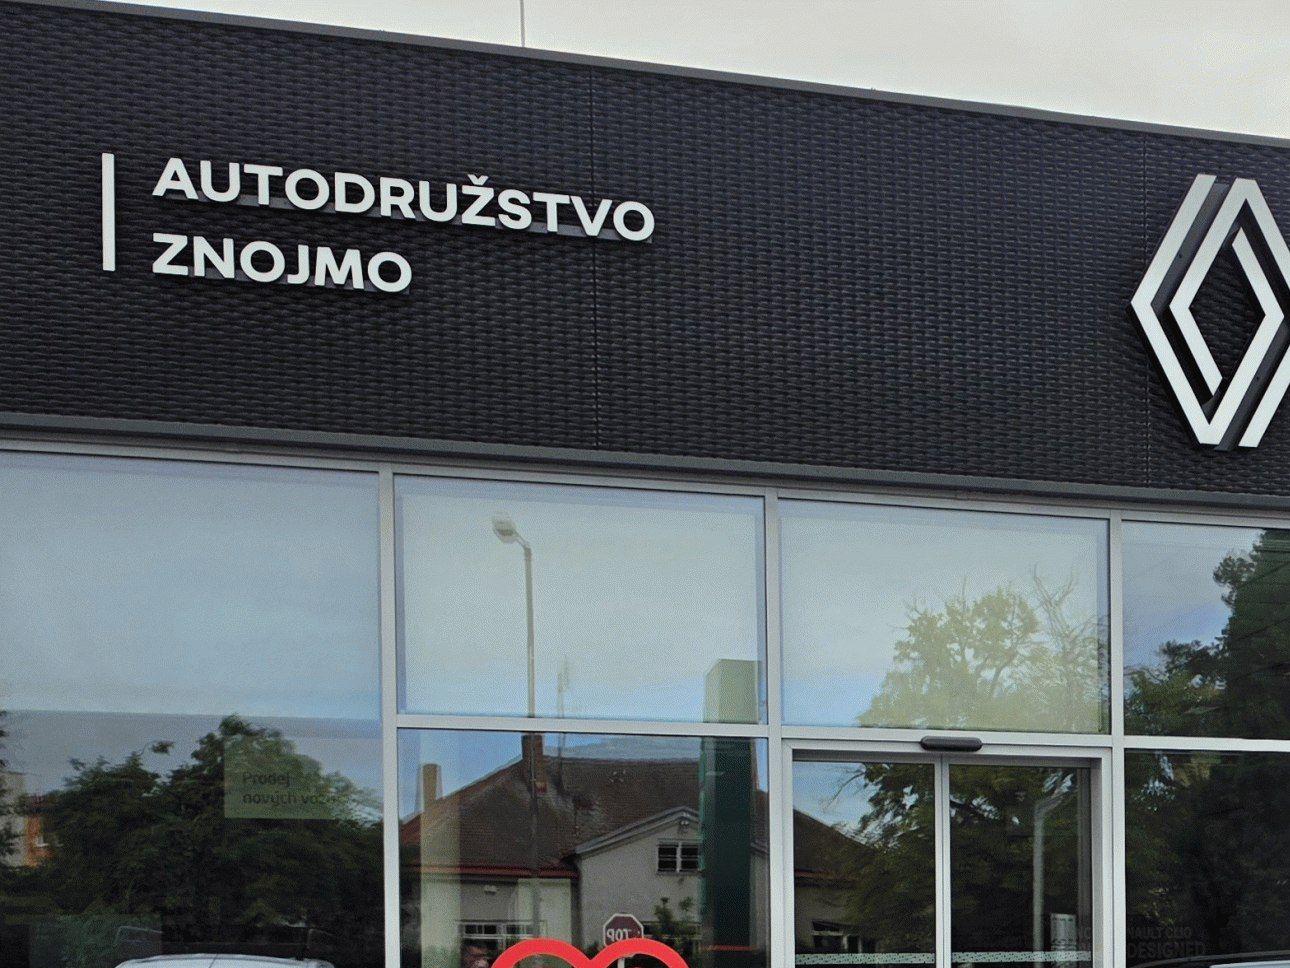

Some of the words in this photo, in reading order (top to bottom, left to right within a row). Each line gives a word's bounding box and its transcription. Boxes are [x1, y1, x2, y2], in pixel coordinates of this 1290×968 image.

[152, 157, 655, 242] AUTODRUŽSTVO
[152, 232, 412, 292] ZNOJMO
[242, 771, 291, 788] Prodej
